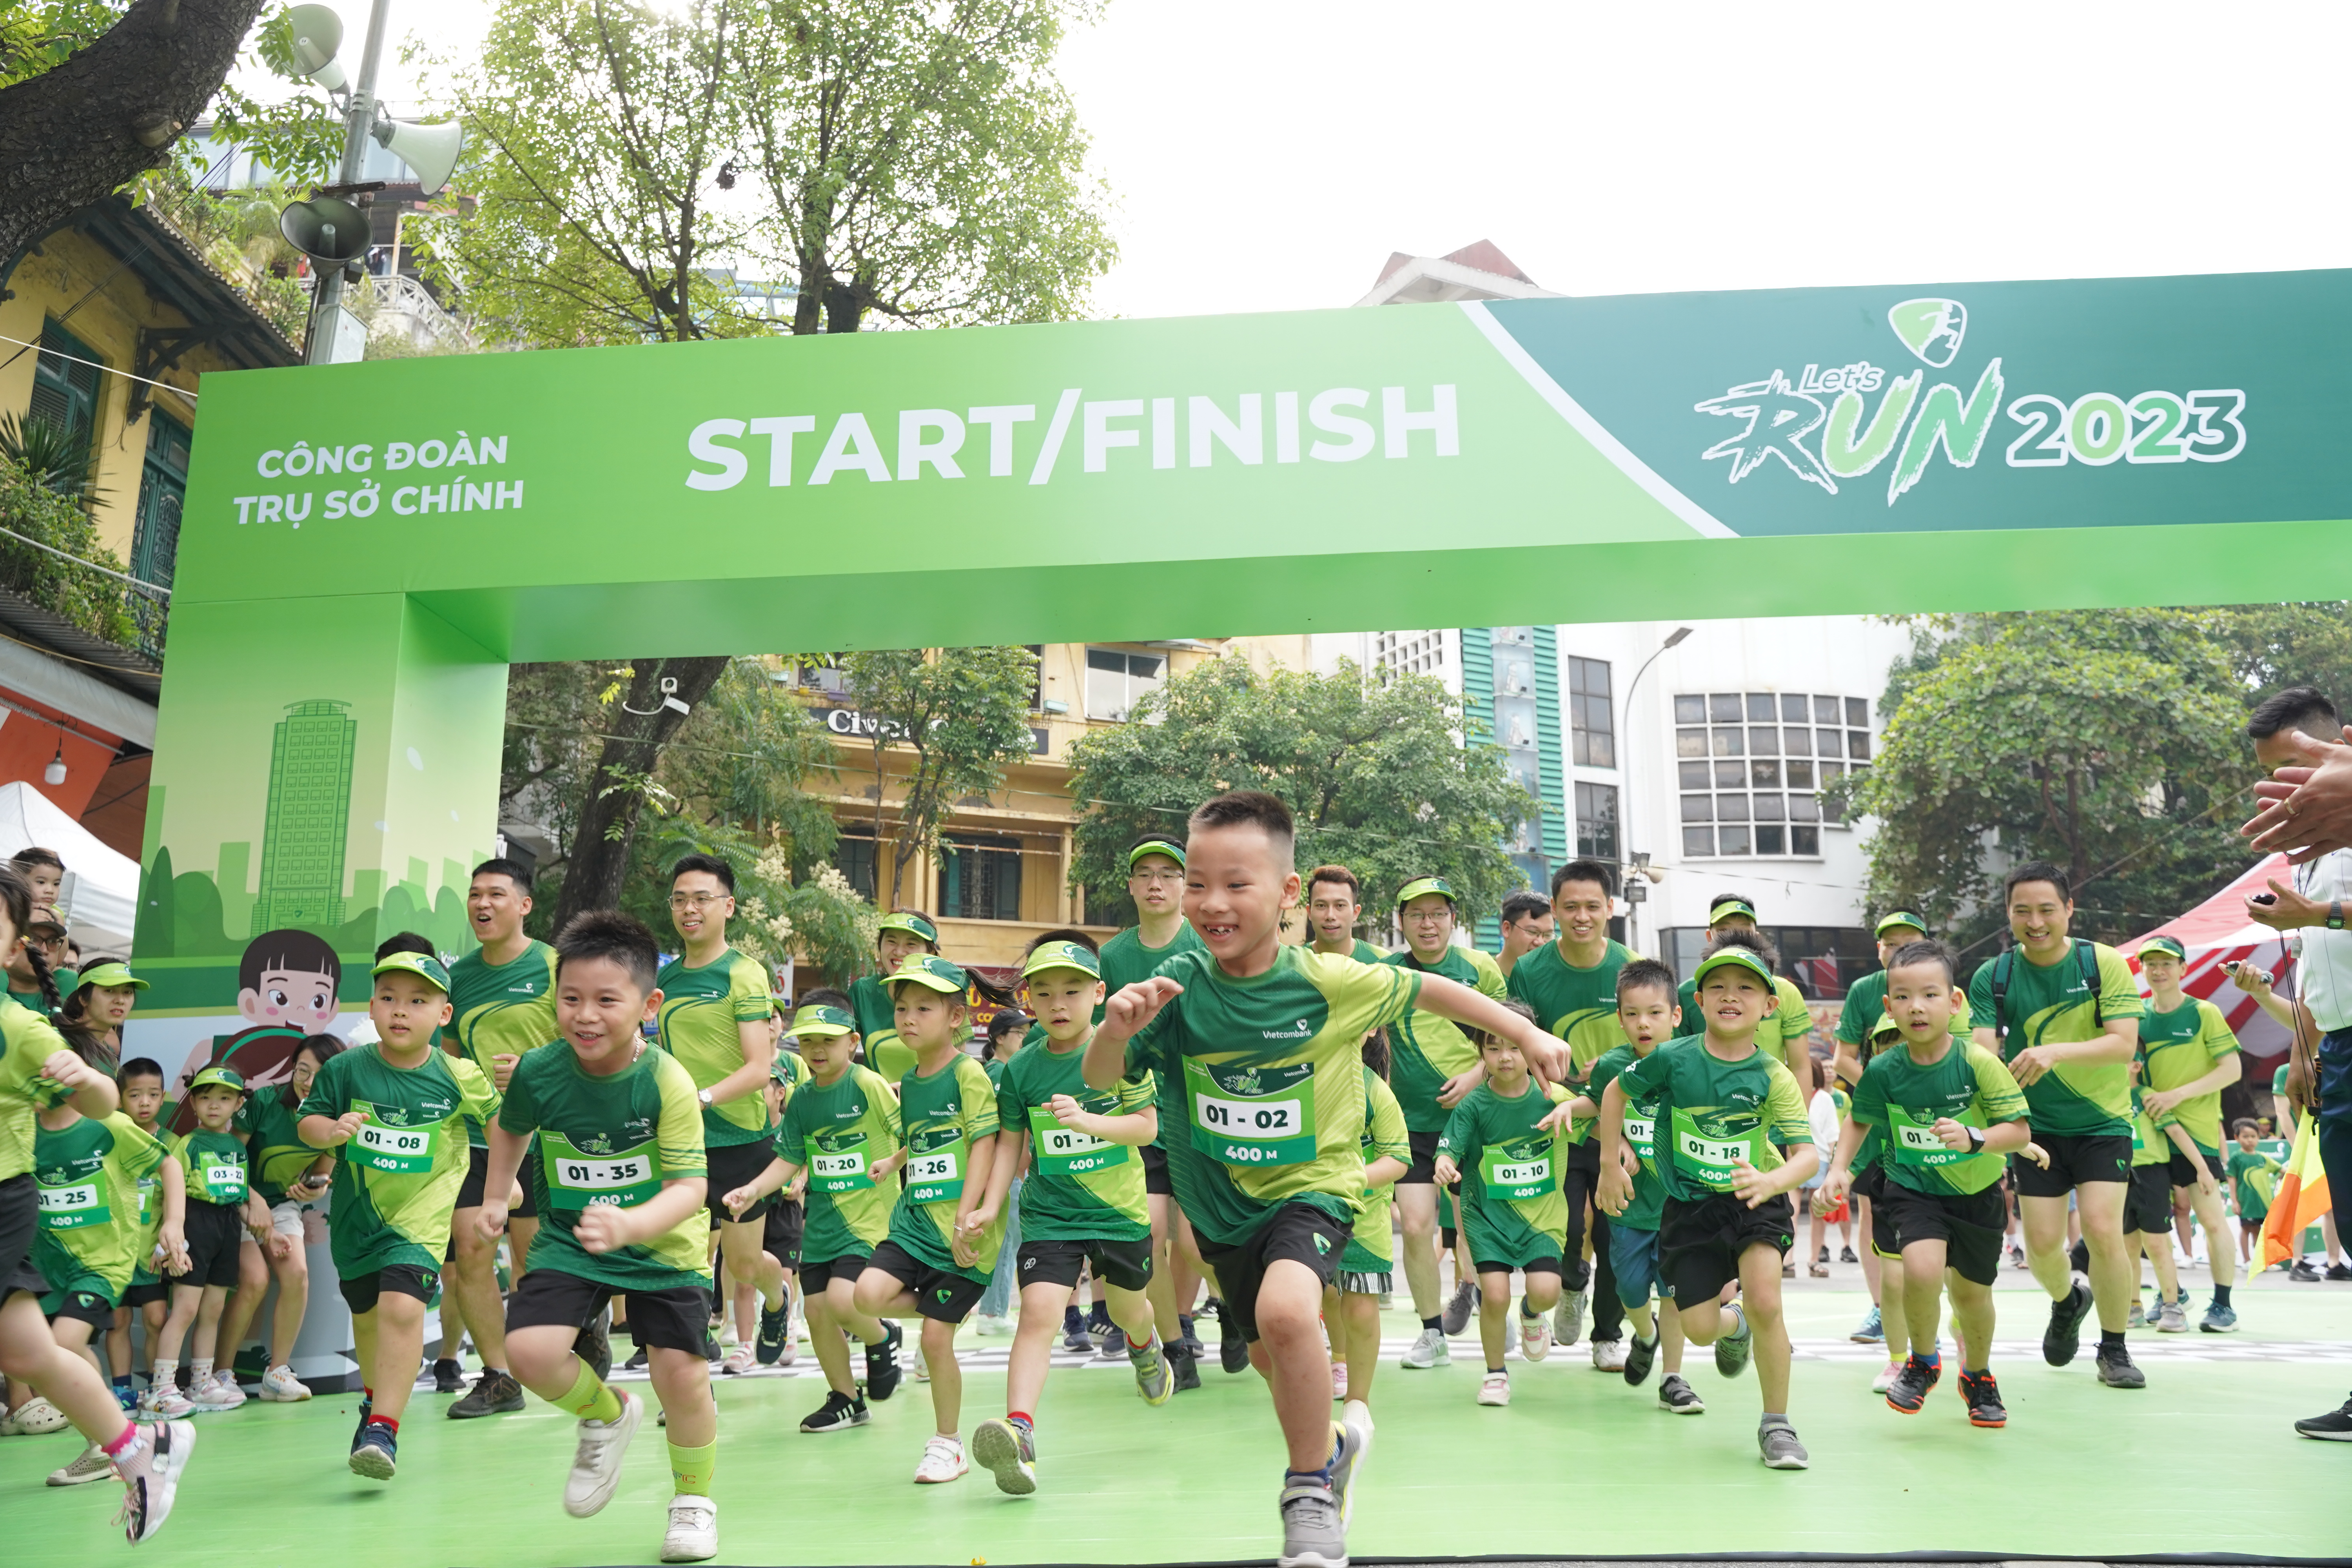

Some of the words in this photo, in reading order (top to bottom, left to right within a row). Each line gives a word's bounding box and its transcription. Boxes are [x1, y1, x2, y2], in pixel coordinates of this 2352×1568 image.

[1797, 361, 1885, 394] Let's
[684, 384, 1460, 491] START/FINISH
[1694, 357, 2005, 507] RUN
[2005, 388, 2247, 468] 2023
[258, 441, 374, 478] CÔNG
[384, 430, 508, 470] ĐOÀN
[233, 492, 312, 529] TRỤ
[323, 478, 381, 519] SỞ
[392, 475, 524, 515] CHÍNH
[1263, 1028, 1312, 1039] Vietcombank
[421, 1102, 451, 1111] Vietcombank
[836, 1111, 862, 1119] Vietcombank
[1206, 1105, 1228, 1126] 01
[1255, 1110, 1289, 1129] 02
[1631, 1125, 1643, 1136] 01
[365, 1131, 381, 1145] 01
[398, 1137, 420, 1149] 08
[1053, 1135, 1071, 1148] 01
[1907, 1132, 1922, 1144] 01
[1225, 1145, 1262, 1162] 400
[1266, 1150, 1278, 1160] M
[1639, 1147, 1654, 1156] 40
[1689, 1141, 1704, 1156] 01
[1722, 1147, 1740, 1159] 18
[373, 1157, 397, 1170] 400
[817, 1160, 827, 1171] 01
[838, 1158, 856, 1170] 20
[1069, 1158, 1094, 1171] 400
[1923, 1154, 1946, 1164] 400
[568, 1166, 590, 1181] 01
[610, 1163, 638, 1180] 35
[927, 1160, 947, 1174] 26
[1502, 1169, 1517, 1179] 01
[1531, 1165, 1543, 1177] 10
[214, 1170, 227, 1178] 03
[236, 1171, 243, 1180] 22
[1699, 1168, 1723, 1181] 400
[828, 1181, 846, 1191] 400
[1514, 1187, 1535, 1197] 400
[65, 1191, 87, 1204] 25
[589, 1194, 621, 1207] 400
[624, 1193, 634, 1201] M
[914, 1188, 933, 1200] 400
[50, 1216, 73, 1226] 400
